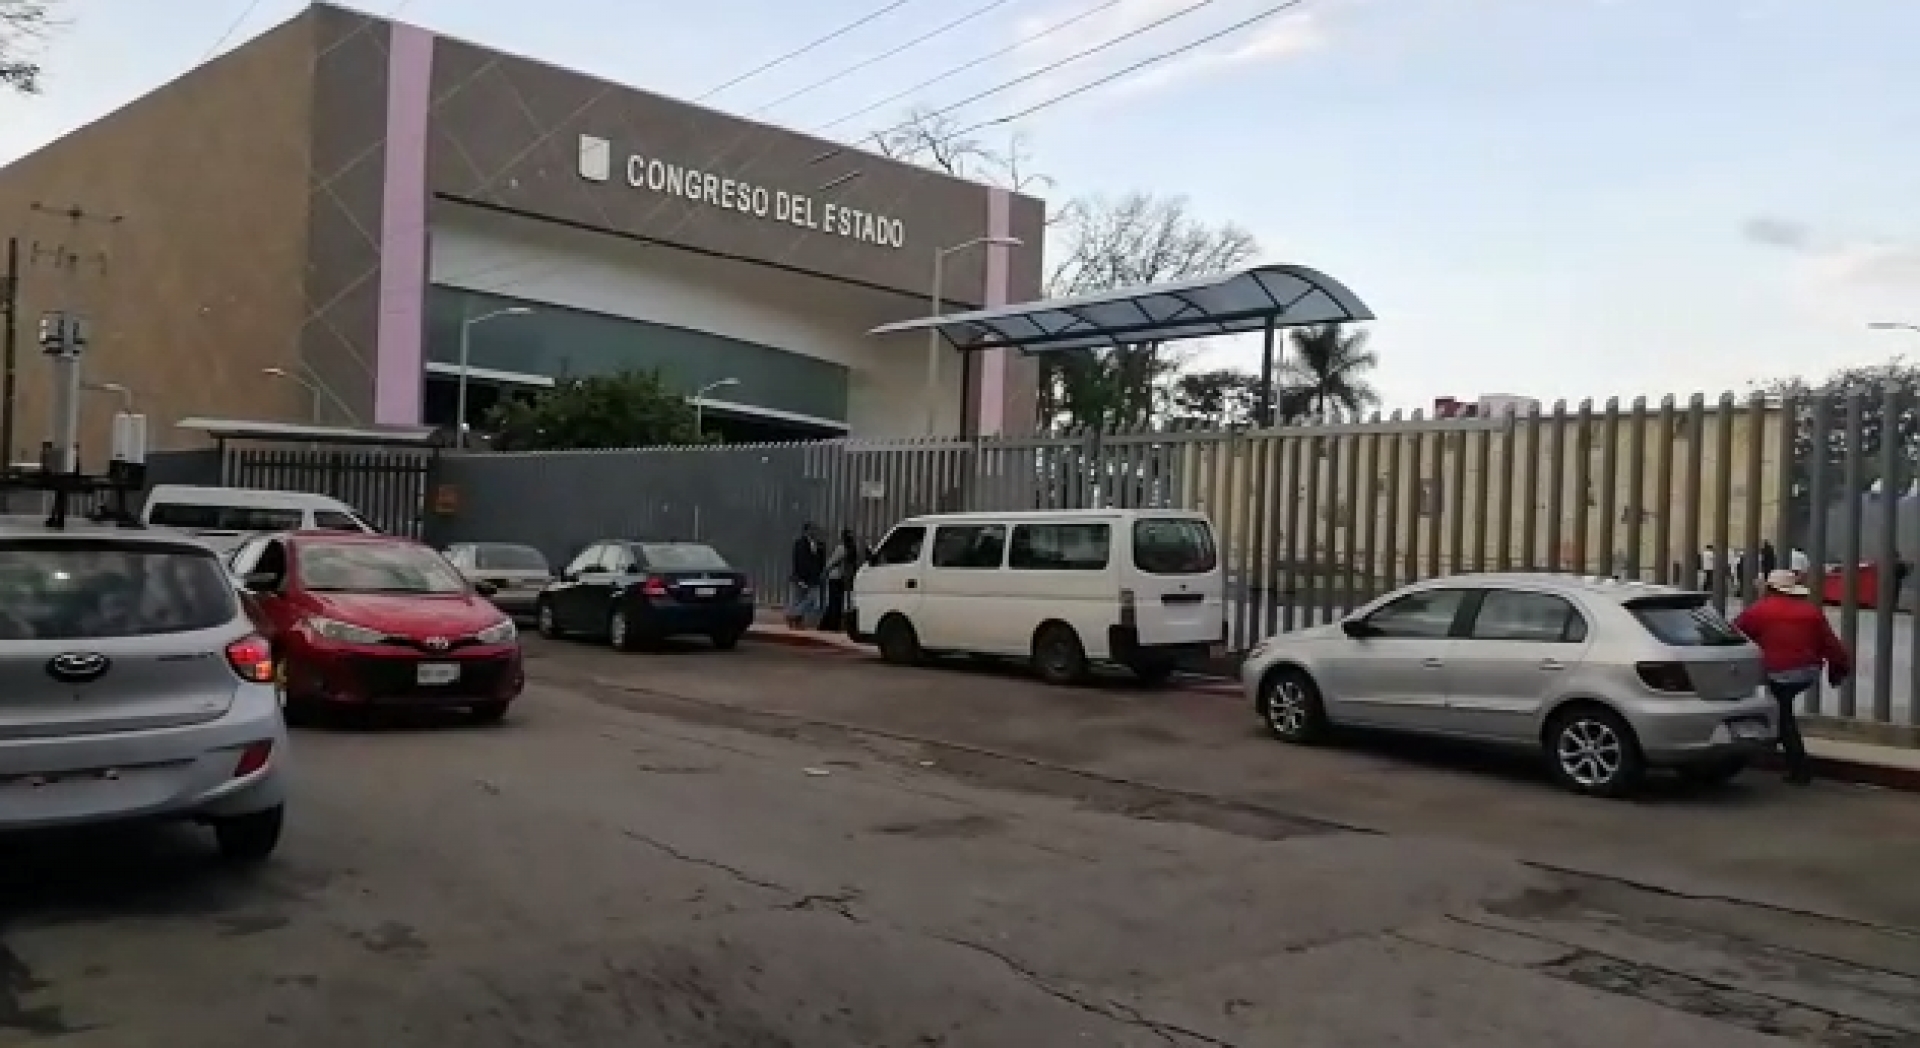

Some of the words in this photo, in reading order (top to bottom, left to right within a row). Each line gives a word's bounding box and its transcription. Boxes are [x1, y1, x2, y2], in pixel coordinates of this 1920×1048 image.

[627, 154, 769, 217] CONGRESO
[775, 190, 817, 229] DEL
[822, 203, 904, 248] ESTADO
